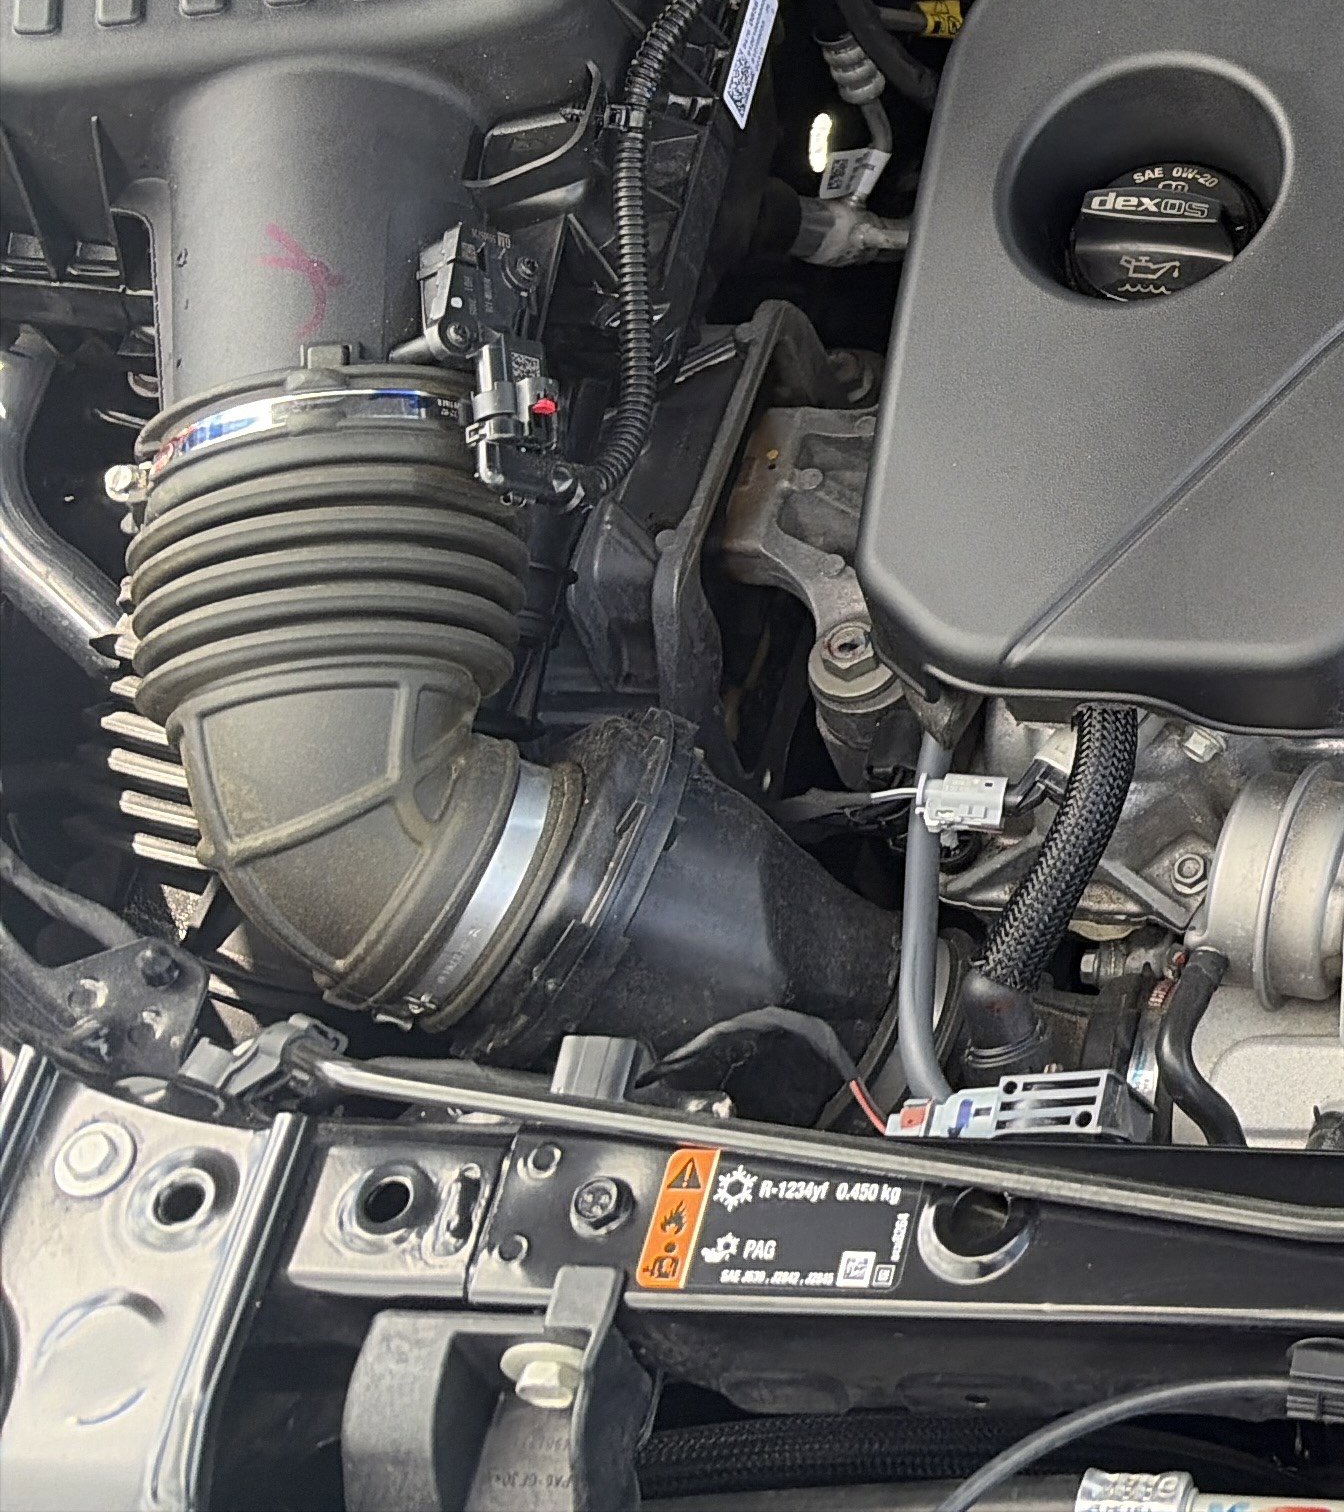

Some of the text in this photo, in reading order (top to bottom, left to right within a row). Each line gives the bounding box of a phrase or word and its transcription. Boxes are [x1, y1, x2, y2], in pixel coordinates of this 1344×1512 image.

[1133, 166, 1219, 188] SAE 0W-20
[1091, 192, 1210, 219] dexos
[759, 1180, 902, 1206] R-1234yf 0.450 kg
[743, 1239, 777, 1260] PAG
